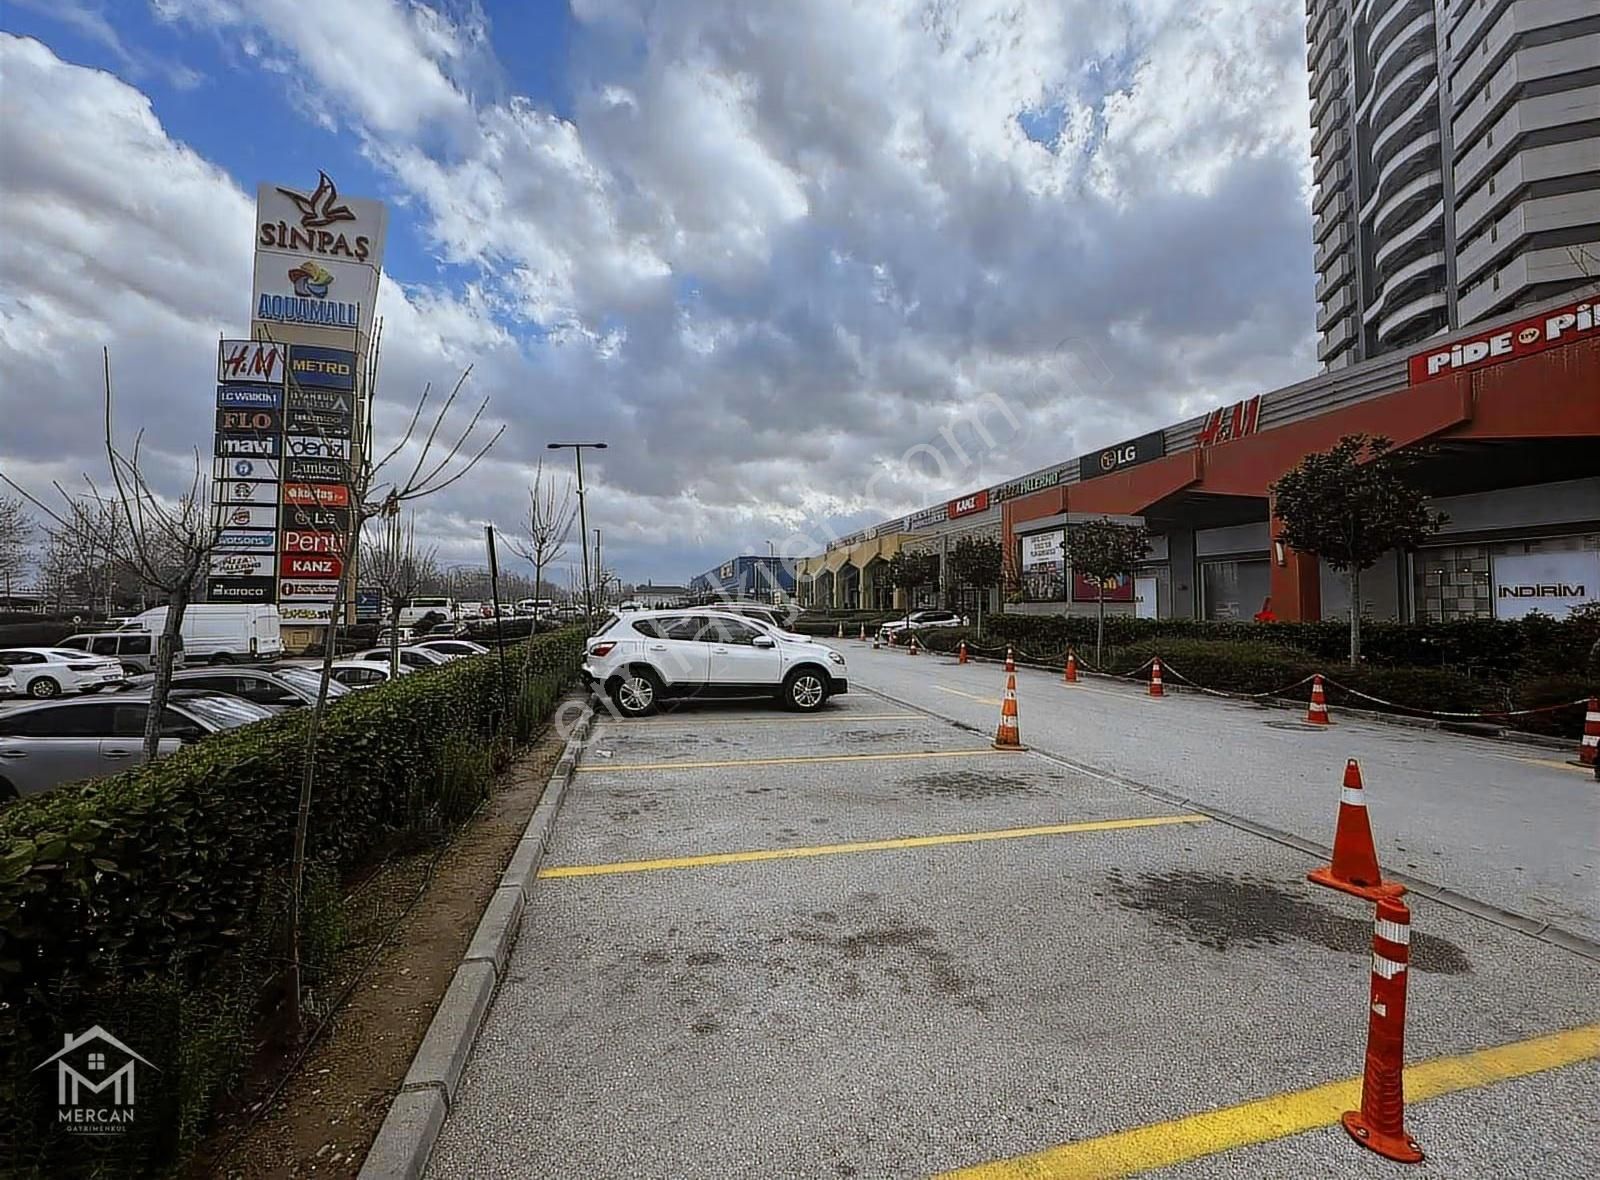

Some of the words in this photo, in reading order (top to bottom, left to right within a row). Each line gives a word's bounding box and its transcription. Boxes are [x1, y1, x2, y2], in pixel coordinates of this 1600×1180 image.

[260, 221, 369, 262] SİNPAŞ
[225, 345, 276, 376] H&M
[293, 359, 350, 375] METRO
[222, 411, 272, 429] FLO
[221, 436, 273, 454] mavi
[1118, 446, 1136, 464] LG
[315, 512, 336, 524] LG
[286, 531, 344, 552] Penti
[292, 561, 332, 573] KANZ
